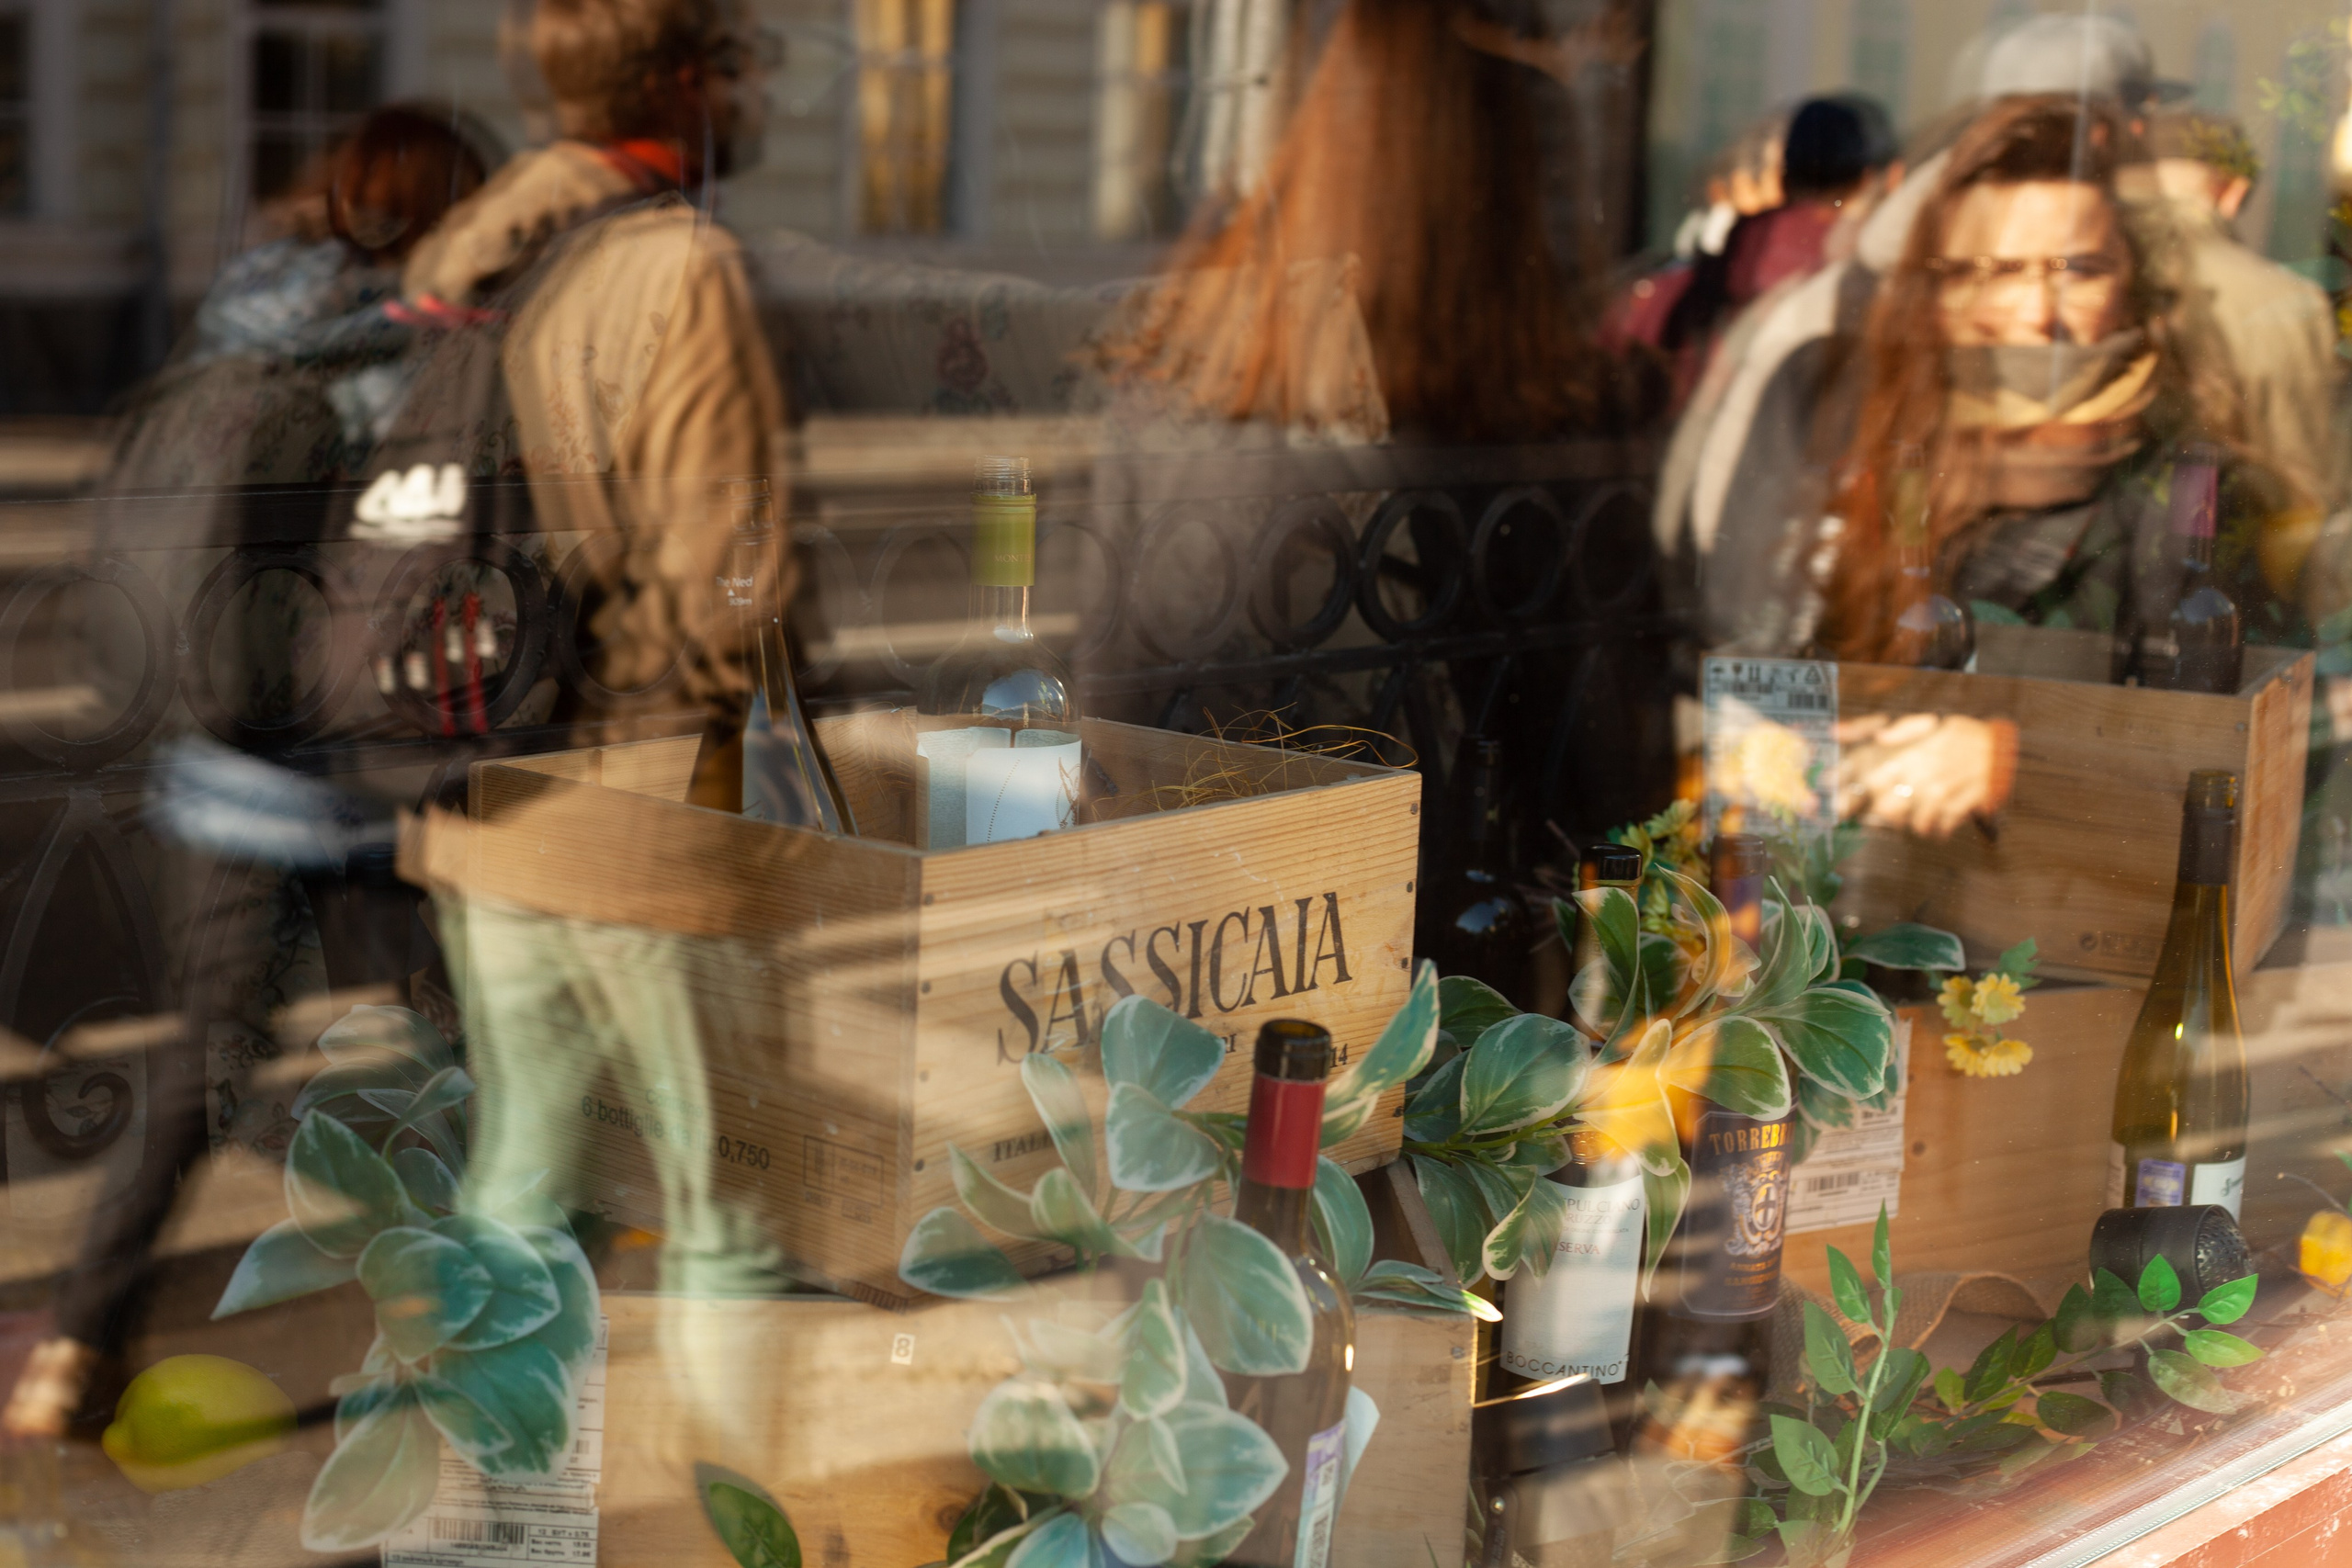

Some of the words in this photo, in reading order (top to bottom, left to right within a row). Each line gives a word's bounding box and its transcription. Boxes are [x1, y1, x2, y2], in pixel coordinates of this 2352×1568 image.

[731, 575, 754, 588] Ned
[997, 890, 1353, 1066] SASSICAIA
[581, 1095, 594, 1118] 6
[596, 1099, 665, 1138] bottiglie
[717, 1134, 771, 1170] 0,750
[895, 1337, 910, 1358] 8
